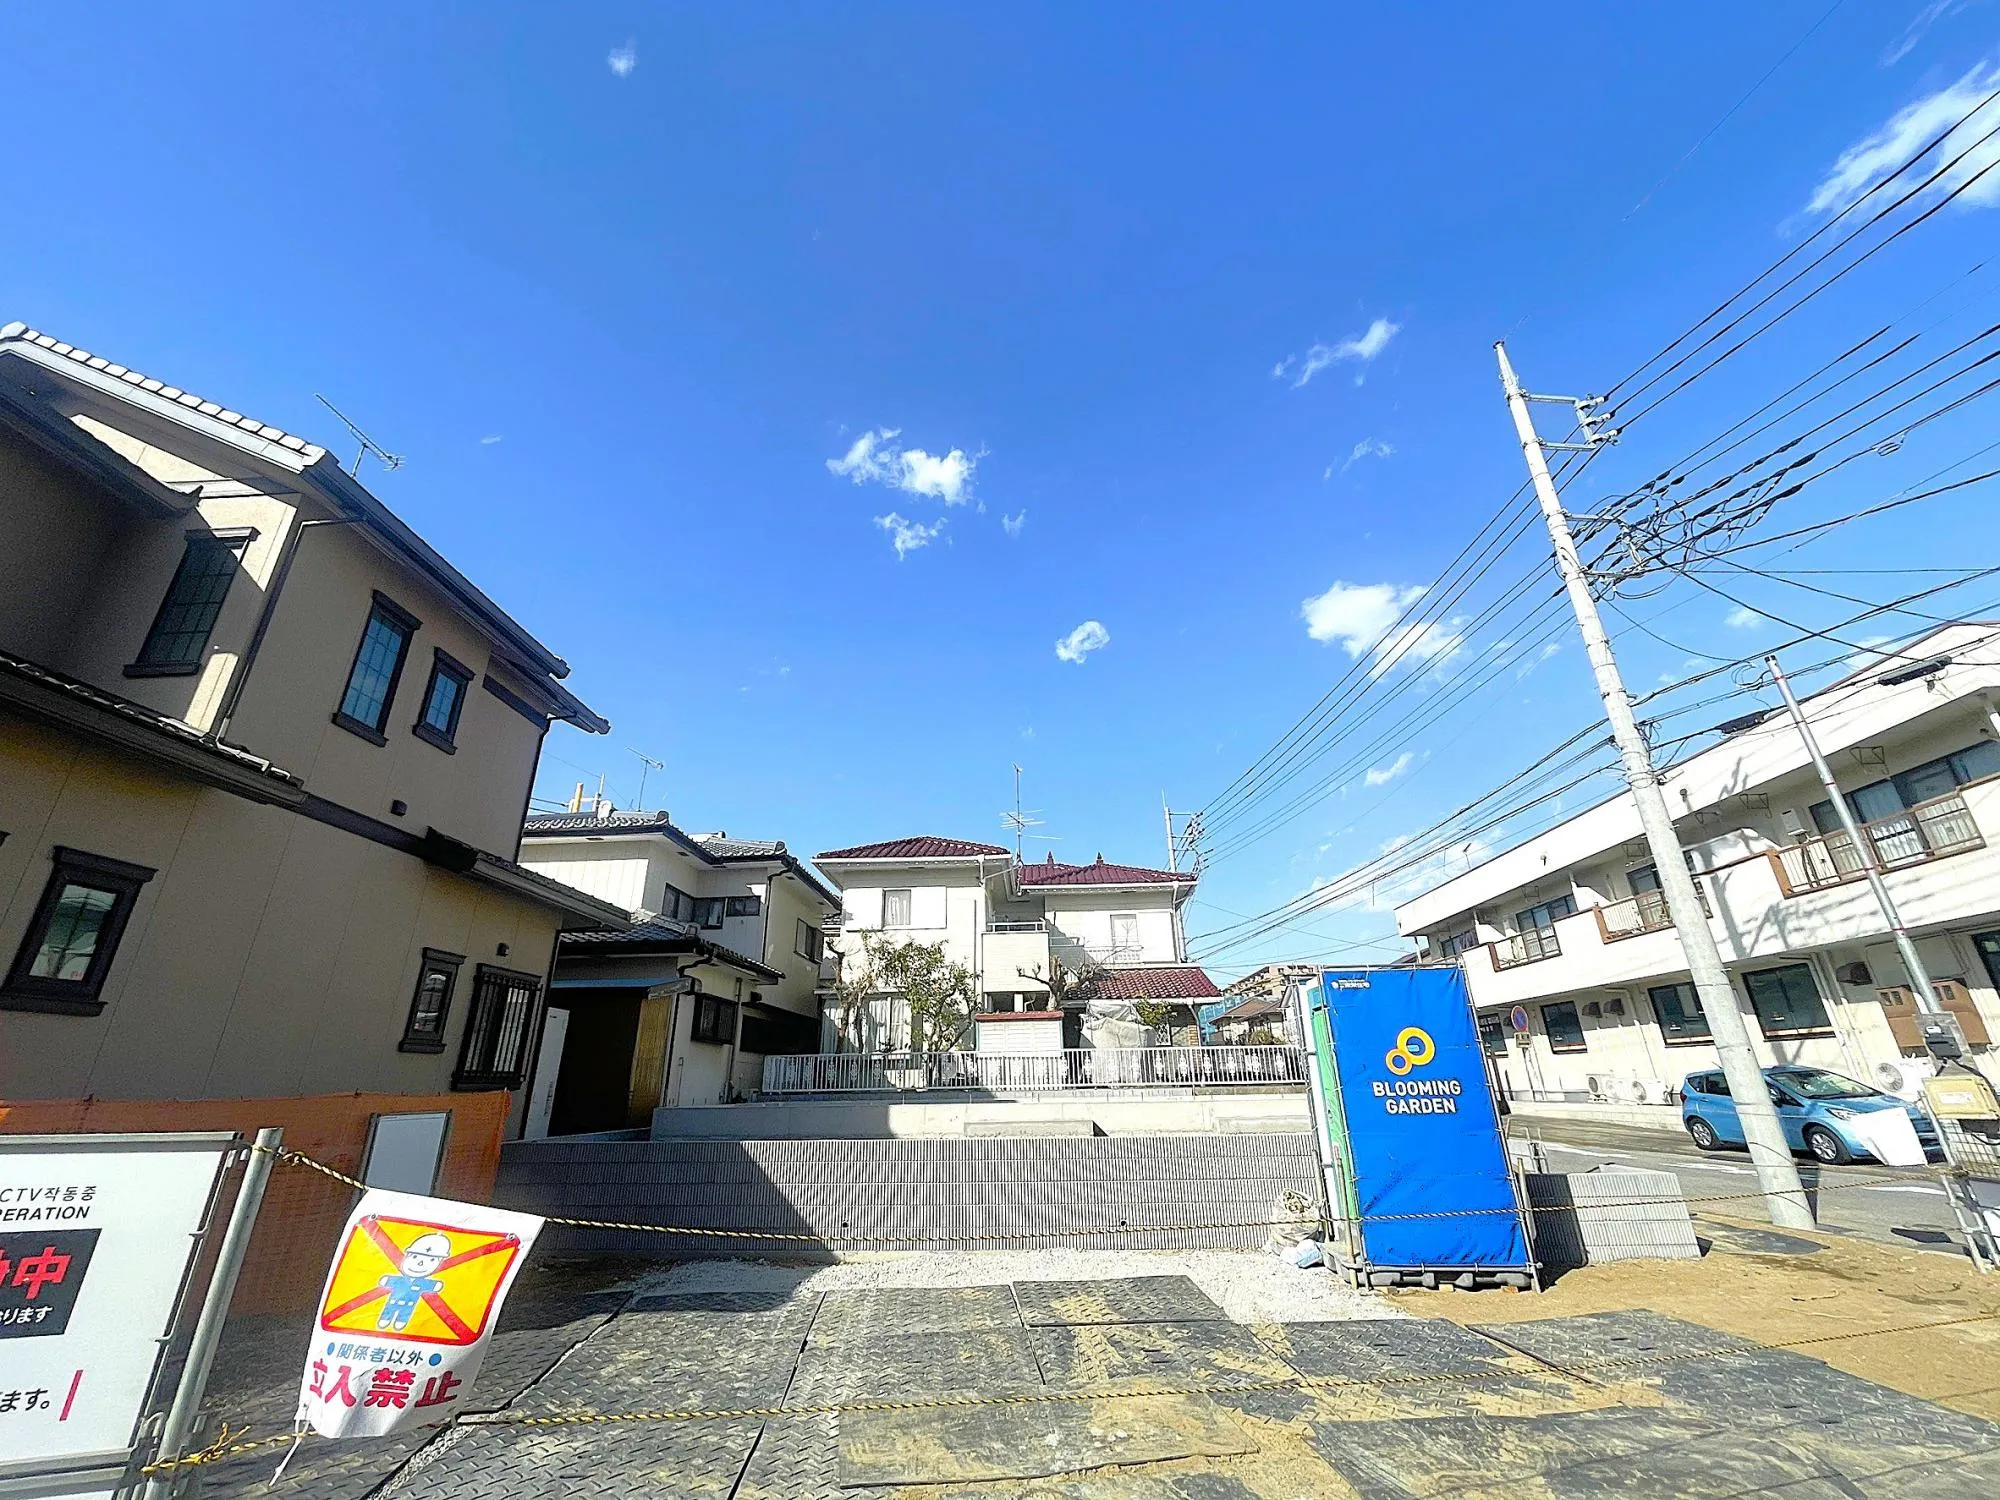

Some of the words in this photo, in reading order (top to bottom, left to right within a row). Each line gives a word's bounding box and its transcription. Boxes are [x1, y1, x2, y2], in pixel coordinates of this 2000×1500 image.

[1372, 1080, 1461, 1097] BLOOMING
[1385, 1097, 1456, 1115] GARDEN
[0, 1205, 90, 1222] ERATION
[0, 1246, 72, 1300] 中
[336, 1343, 424, 1367] 関係者以外
[309, 1358, 463, 1410] 立入禁止
